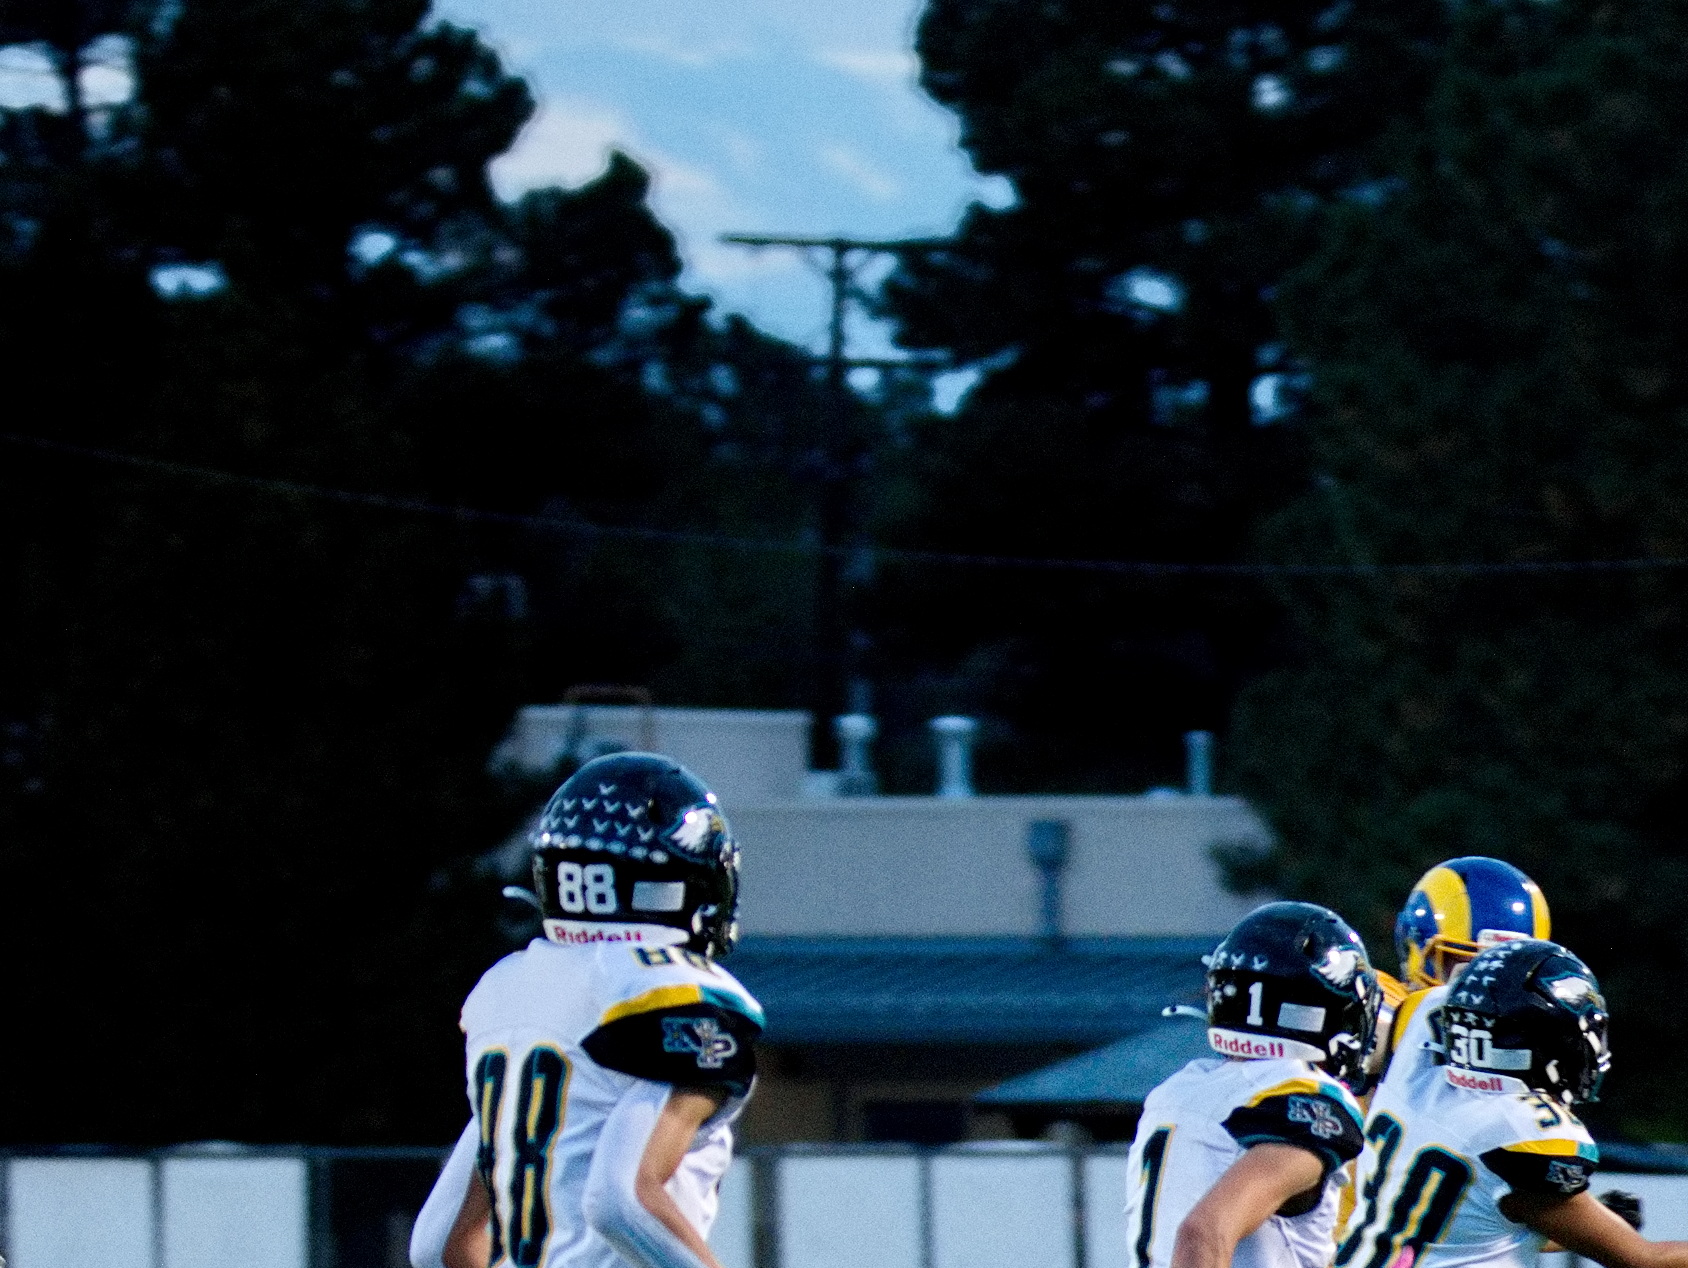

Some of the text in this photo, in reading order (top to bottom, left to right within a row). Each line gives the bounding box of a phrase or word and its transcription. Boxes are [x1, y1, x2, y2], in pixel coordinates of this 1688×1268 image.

[557, 861, 618, 914] 88
[1246, 981, 1264, 1026] 1
[1213, 1033, 1285, 1058] Riddell
[1451, 1024, 1494, 1070] 30
